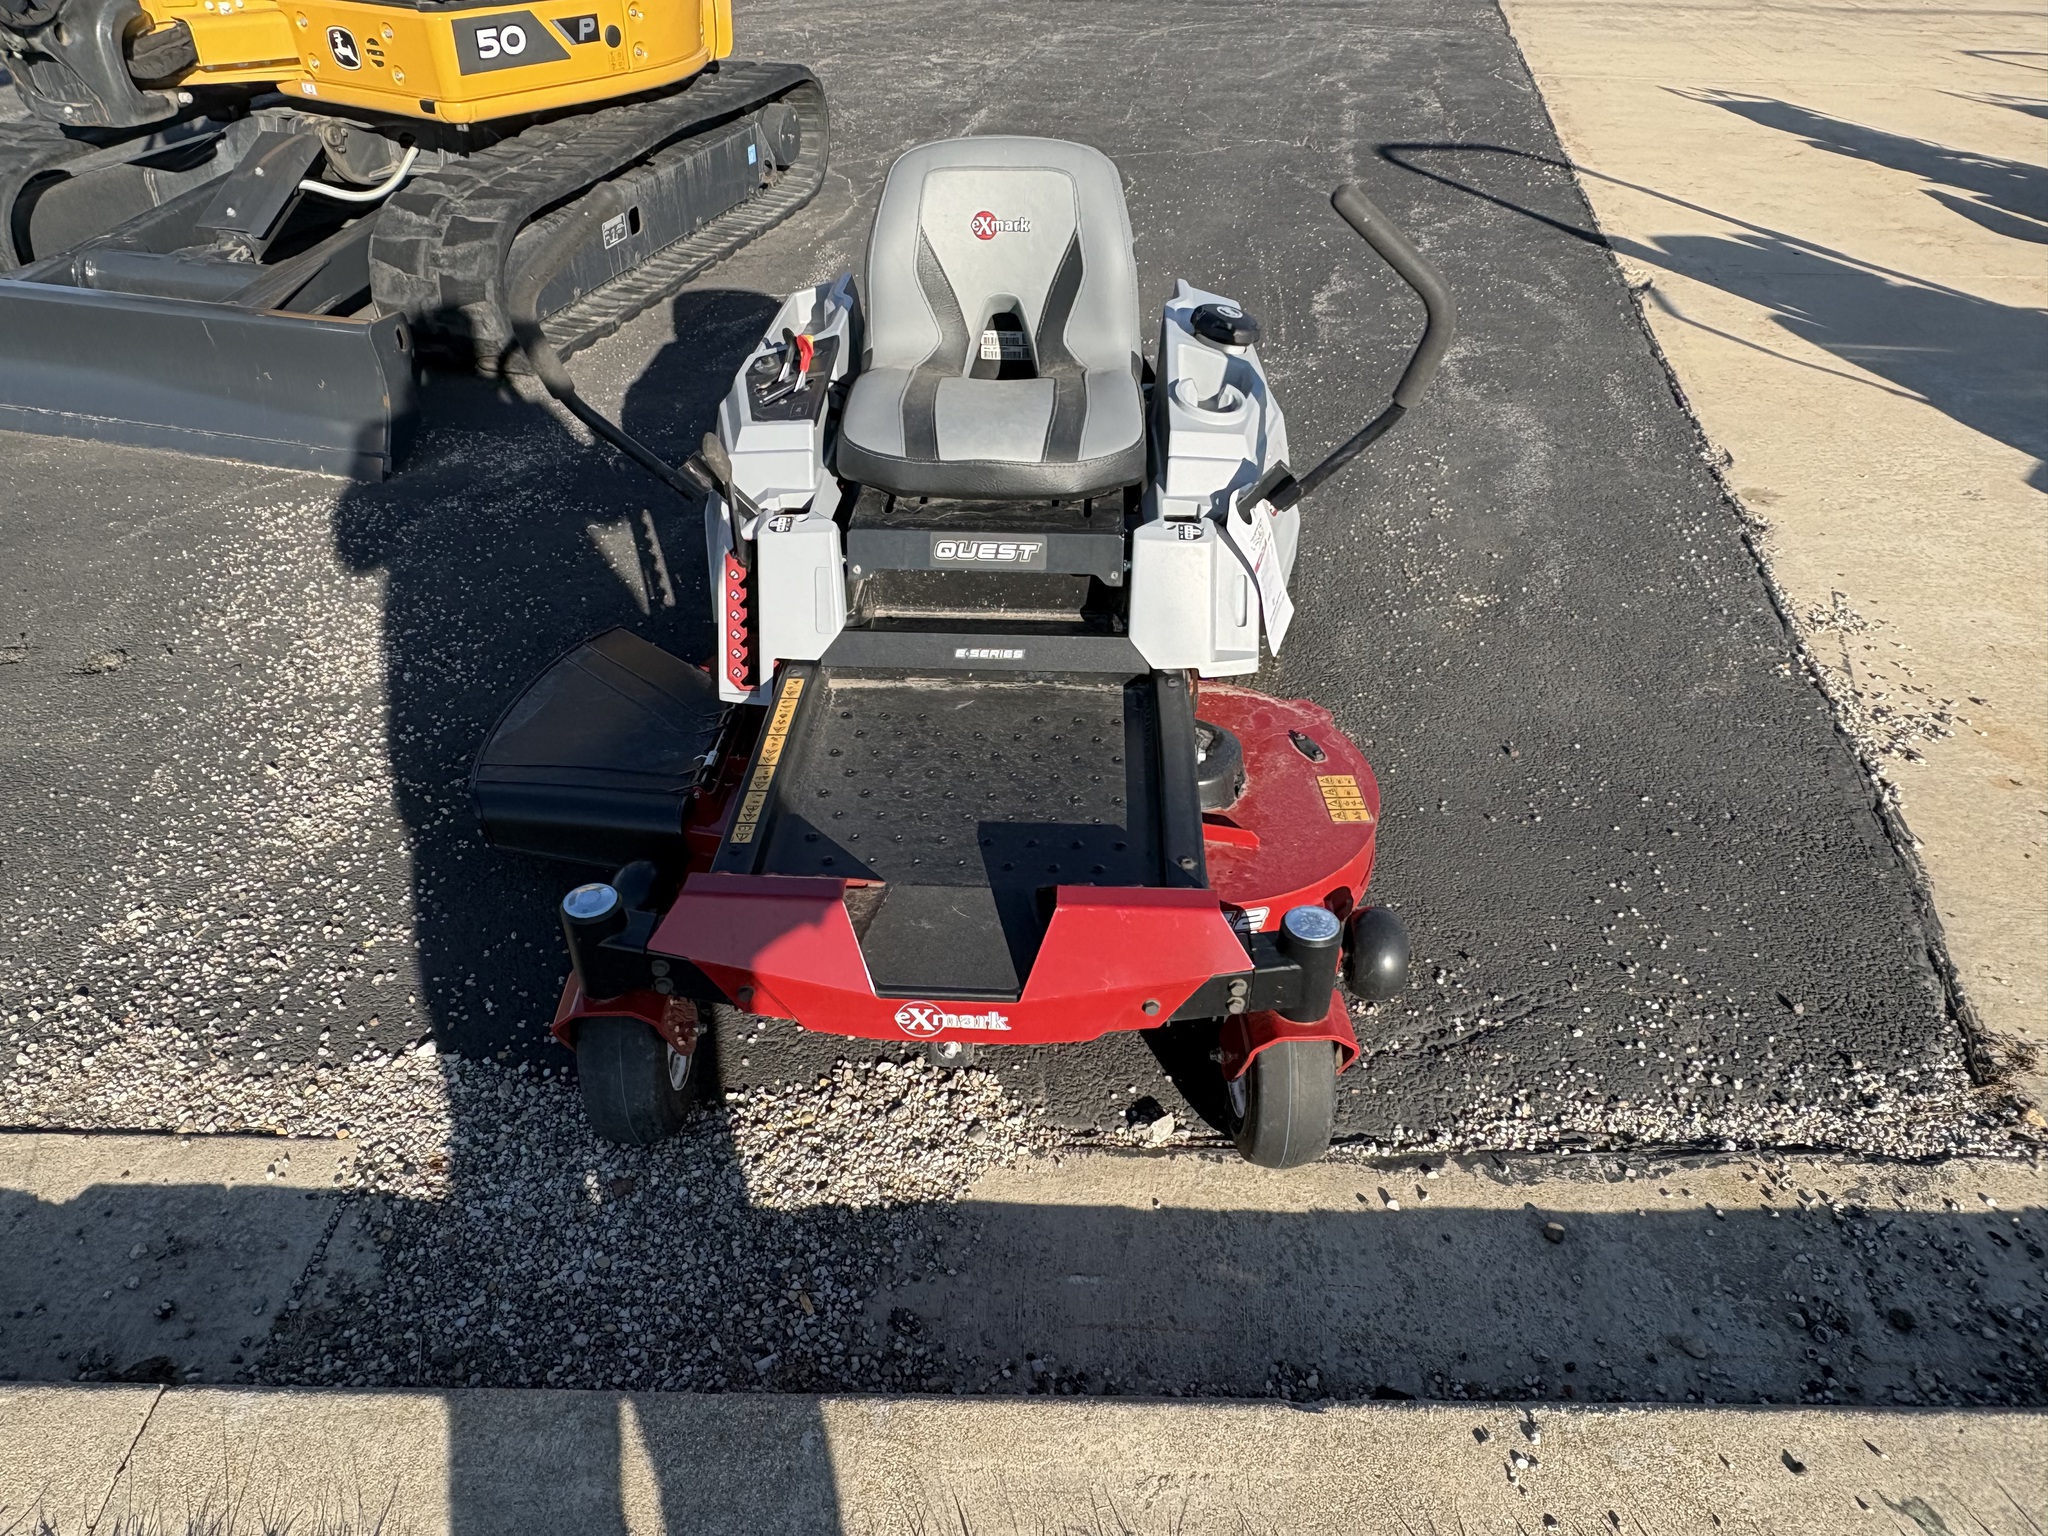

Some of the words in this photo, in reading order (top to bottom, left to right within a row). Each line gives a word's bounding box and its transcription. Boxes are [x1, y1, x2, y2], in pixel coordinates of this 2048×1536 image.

[476, 25, 527, 59] 50
[579, 18, 595, 41] P
[934, 540, 1042, 562] QUEST
